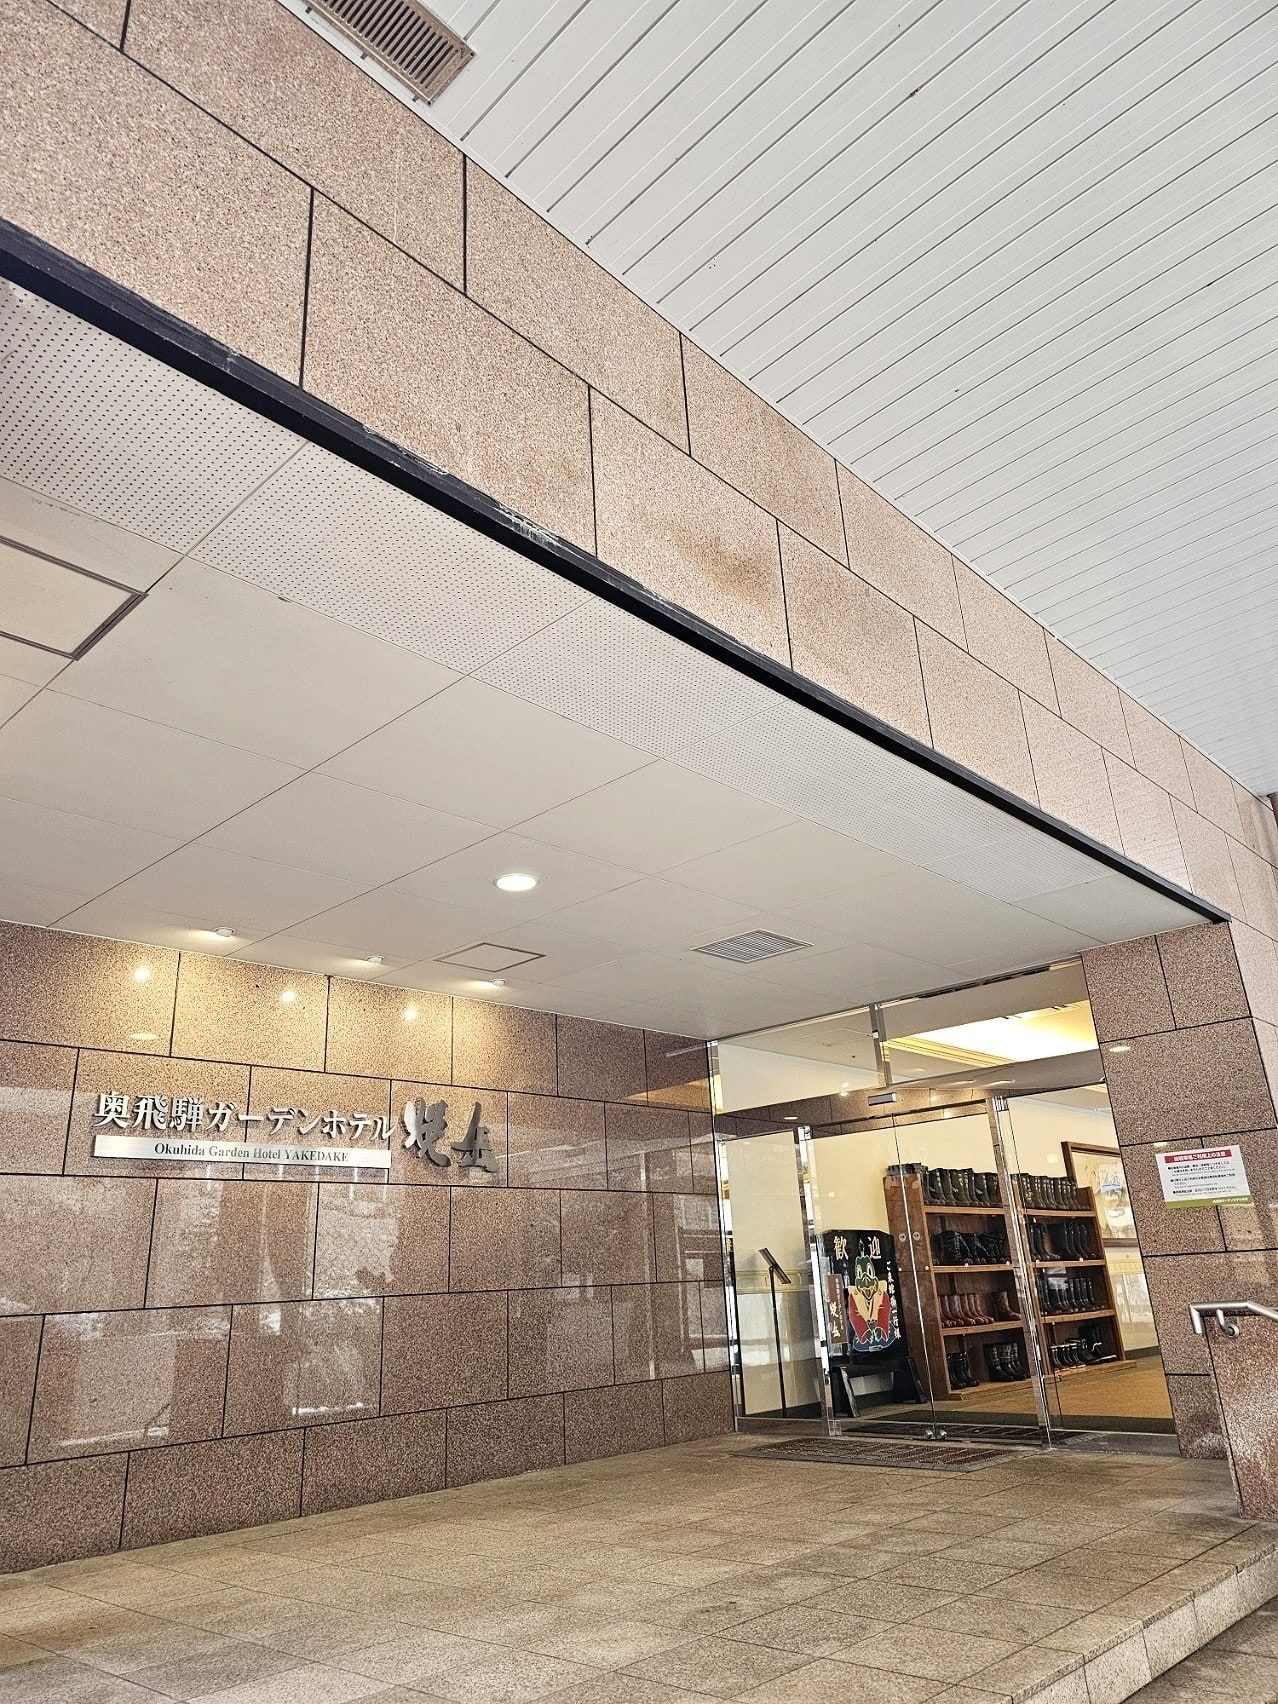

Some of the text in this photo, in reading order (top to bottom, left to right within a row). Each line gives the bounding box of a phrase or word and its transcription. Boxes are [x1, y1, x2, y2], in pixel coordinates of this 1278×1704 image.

[94, 1091, 396, 1141] 奥飛騨ガーデンホテル
[154, 1142, 349, 1162] Okuhida Garden Hotel YAKEDAKE
